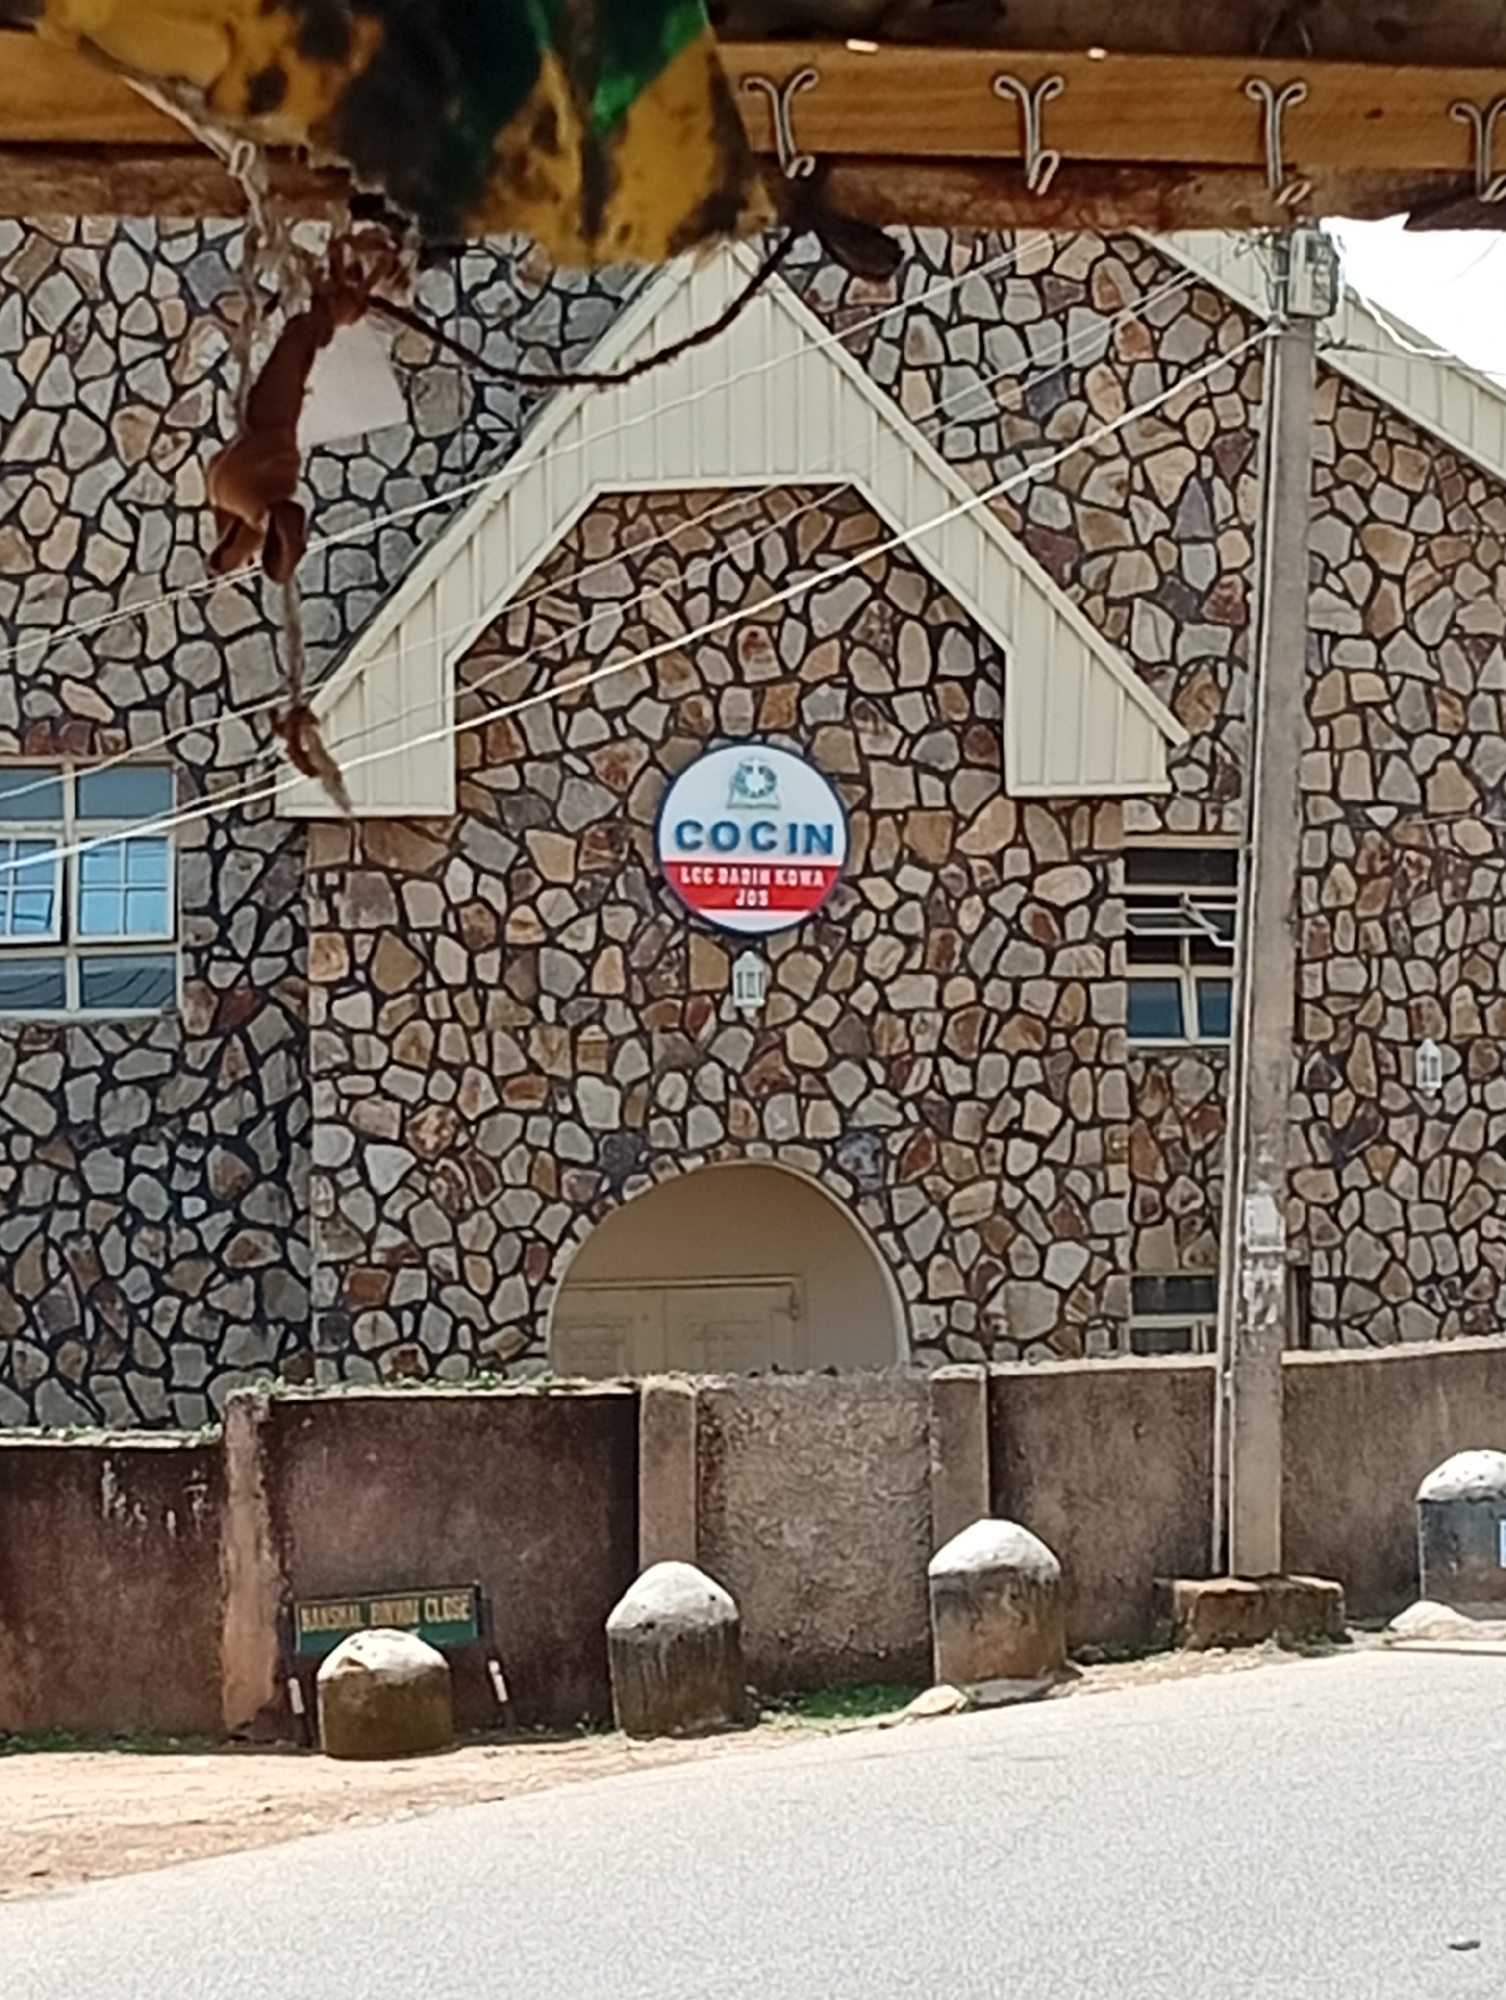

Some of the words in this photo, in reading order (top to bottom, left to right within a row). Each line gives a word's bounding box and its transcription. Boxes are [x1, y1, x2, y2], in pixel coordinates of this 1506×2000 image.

[675, 820, 834, 855] COCIN
[680, 866, 714, 885] LCC
[717, 867, 770, 886] DADIN
[774, 869, 825, 887] KOWA
[735, 889, 769, 906] JOS
[424, 1595, 470, 1623] CLOSE
